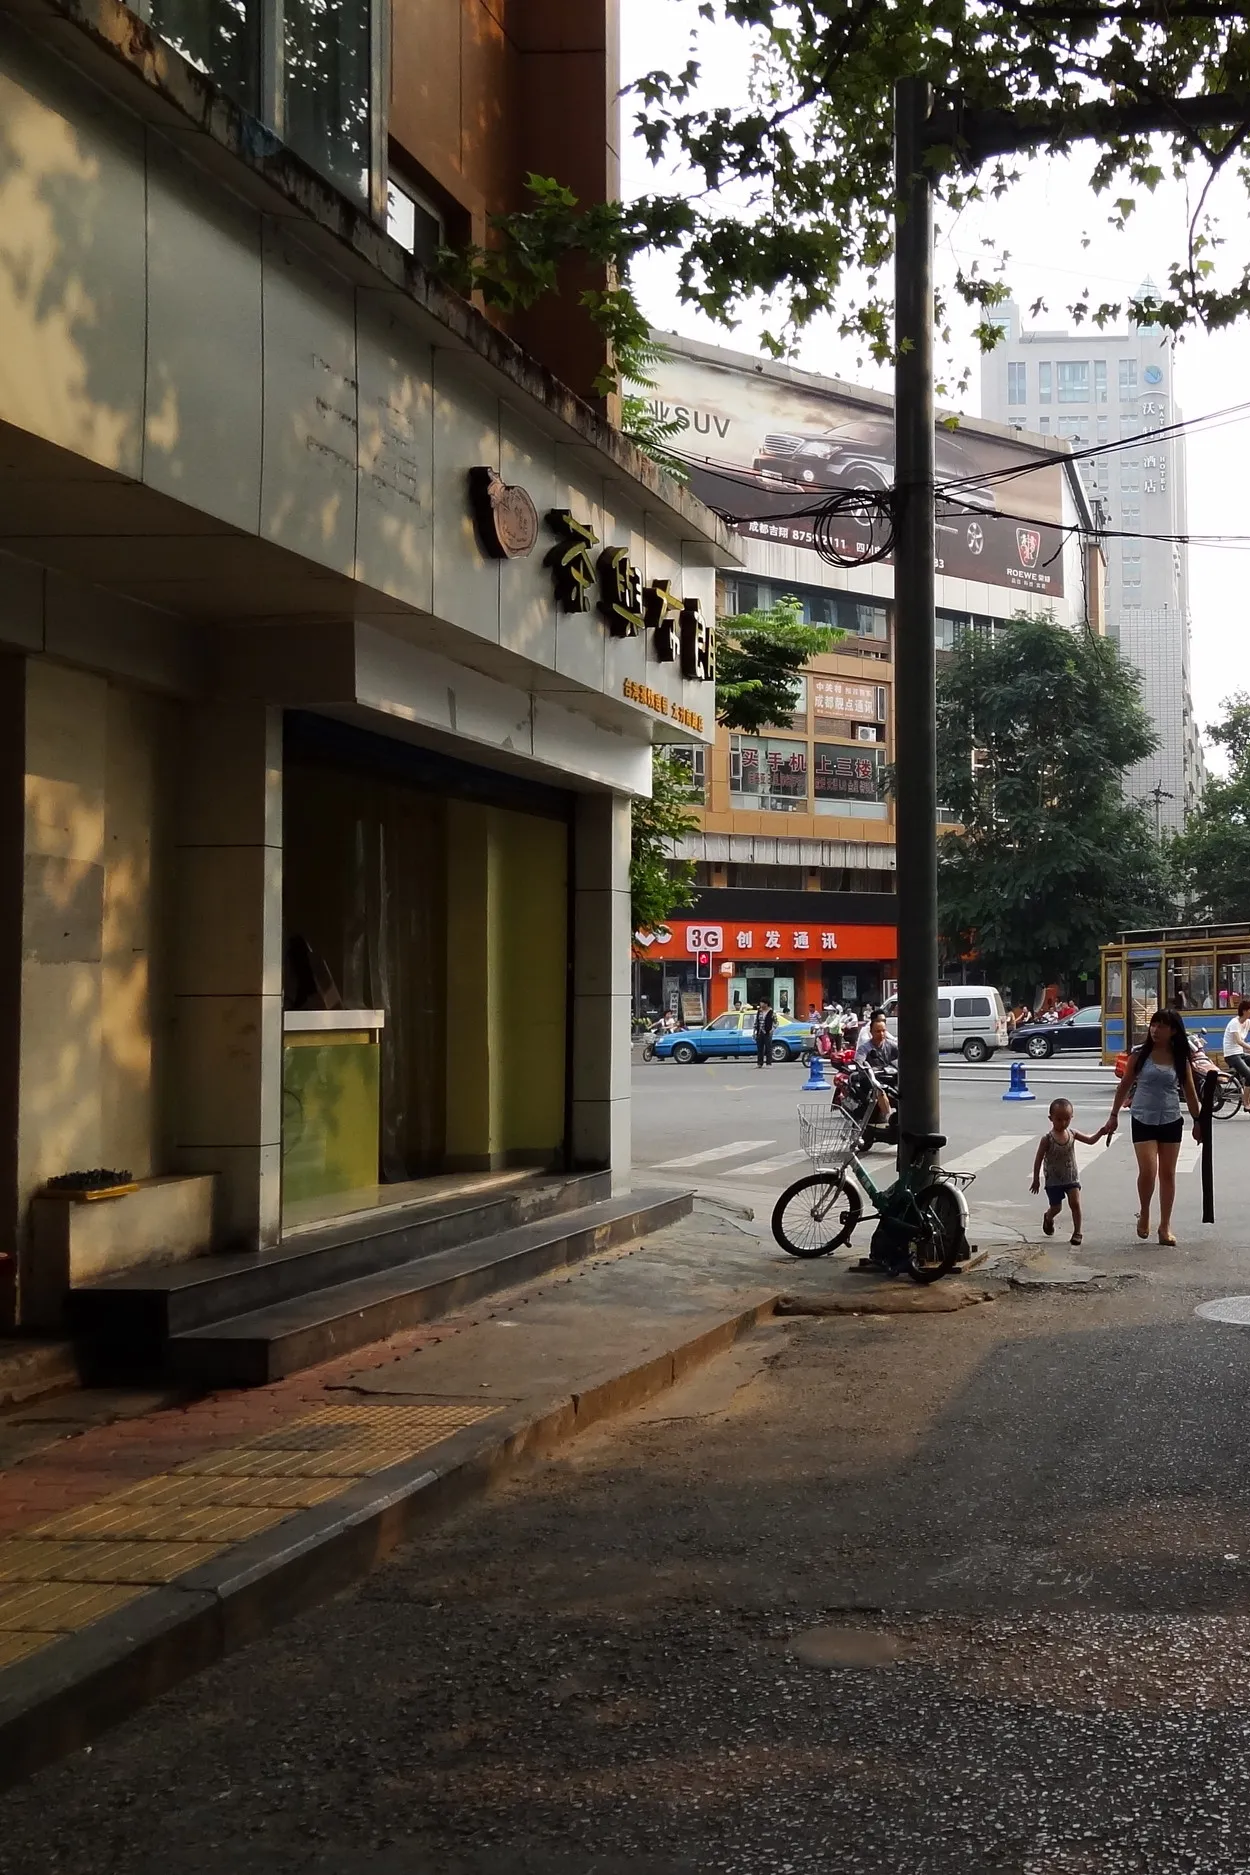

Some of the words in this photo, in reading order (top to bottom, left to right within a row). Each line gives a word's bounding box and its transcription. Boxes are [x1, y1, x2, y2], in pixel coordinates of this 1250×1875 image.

[1157, 403, 1166, 439] WATR
[1159, 456, 1167, 491] HOTEL
[748, 521, 789, 539] 成都吉翔
[1006, 568, 1038, 581] ROEWE
[742, 748, 807, 773] 买手机
[815, 755, 873, 780] 上三楼
[691, 929, 719, 948] 3G
[736, 930, 838, 950] 创发通讯
